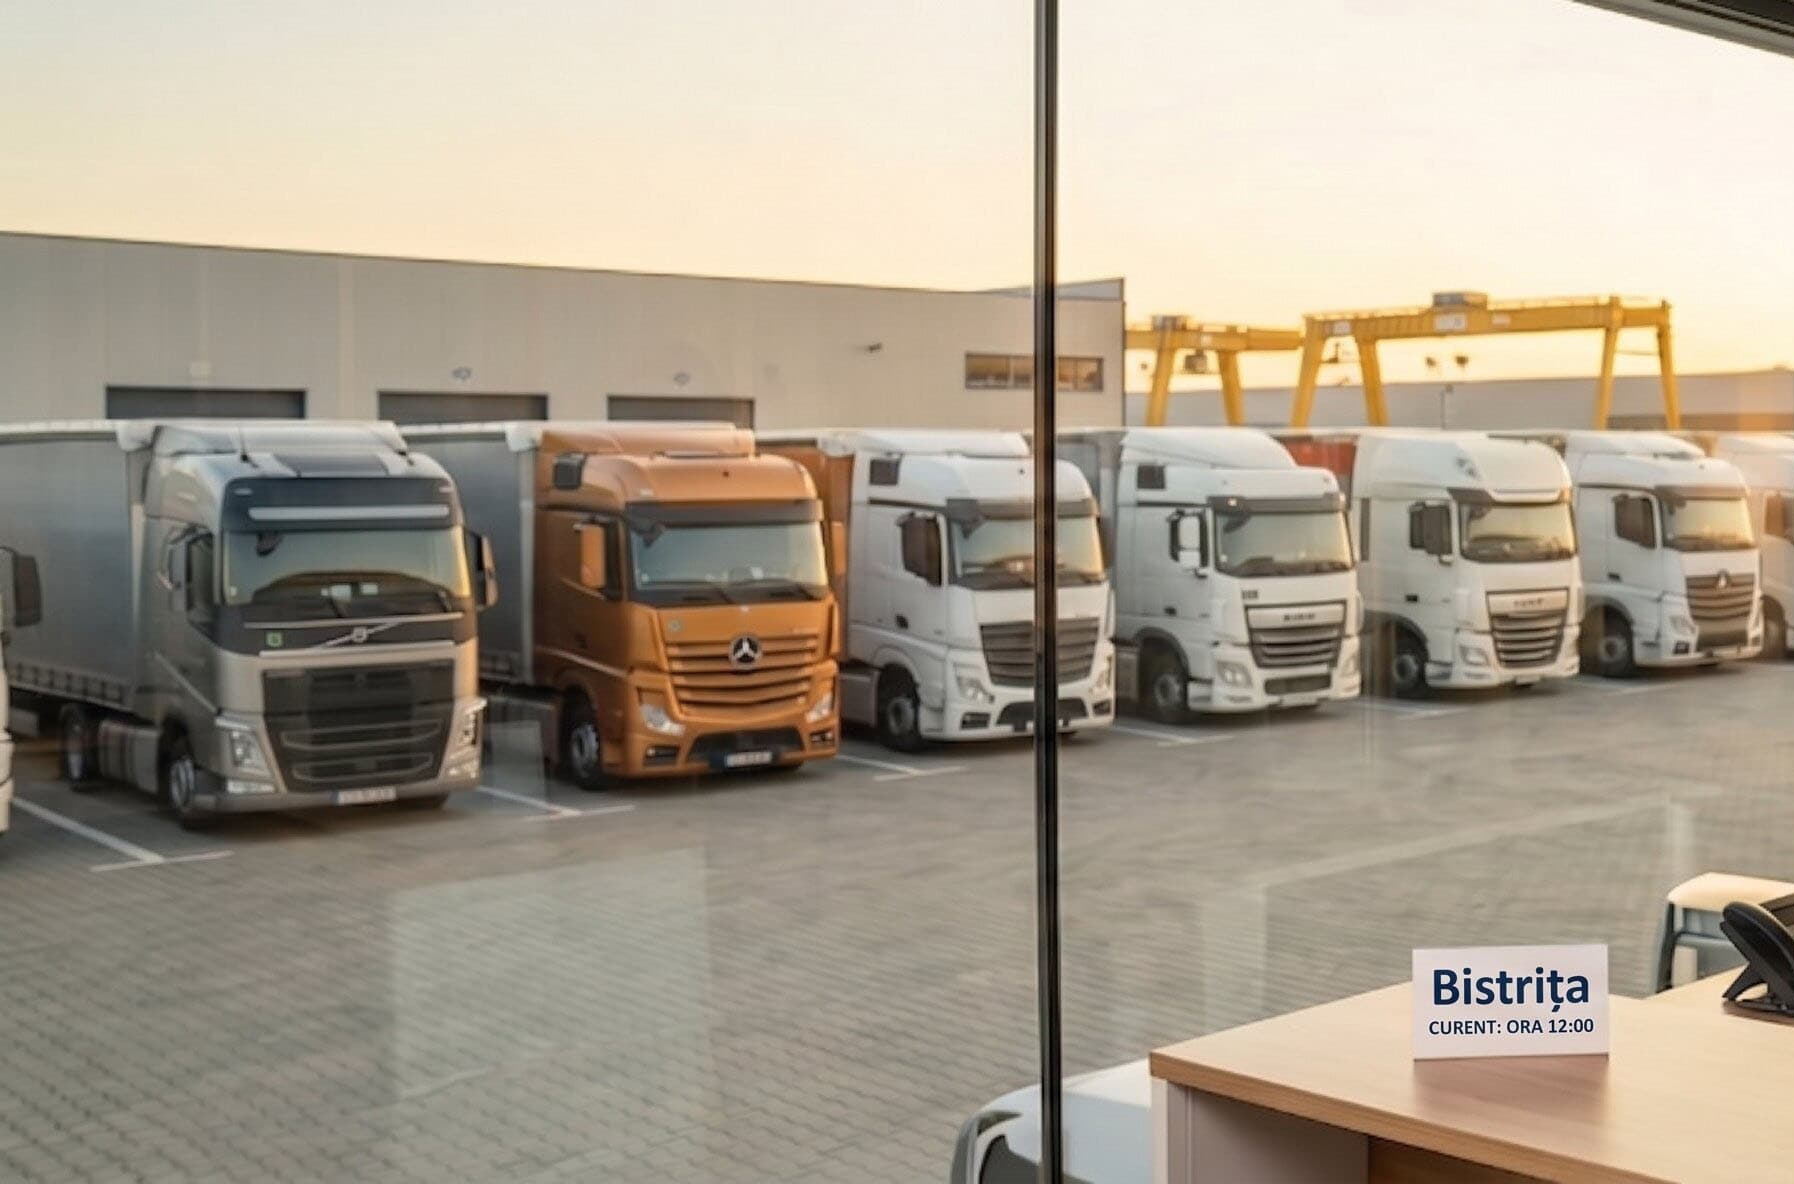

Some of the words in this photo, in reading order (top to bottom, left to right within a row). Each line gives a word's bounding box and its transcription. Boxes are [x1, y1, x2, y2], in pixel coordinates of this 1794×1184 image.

[1433, 966, 1589, 1013] Bistrița
[1428, 1020, 1502, 1035] CURENT:
[1506, 1019, 1543, 1034] ORA
[1548, 1018, 1594, 1033] 12:00
